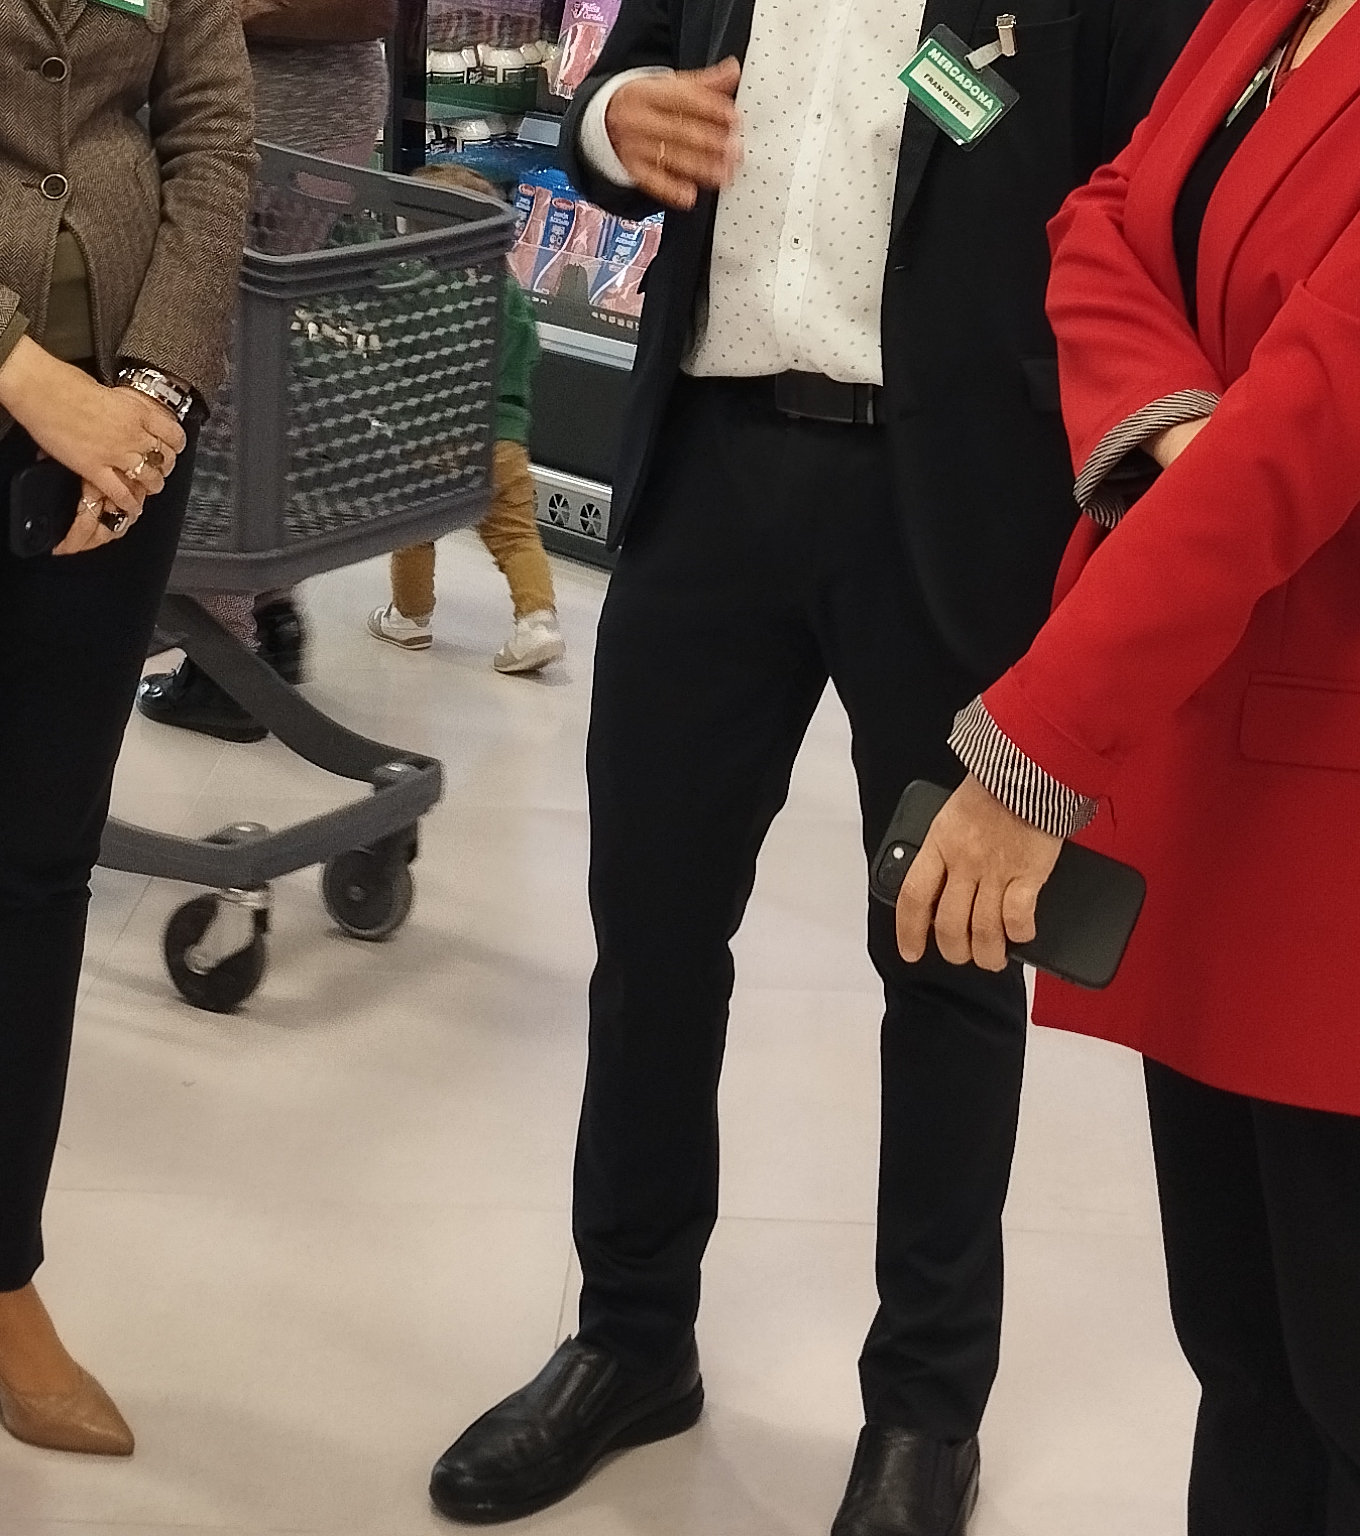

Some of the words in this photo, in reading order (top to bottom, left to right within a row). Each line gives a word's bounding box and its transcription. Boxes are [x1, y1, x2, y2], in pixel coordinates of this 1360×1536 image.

[923, 72, 943, 92] FRAN
[943, 90, 971, 117] ORTEGA
[928, 47, 996, 111] MERCADONA
